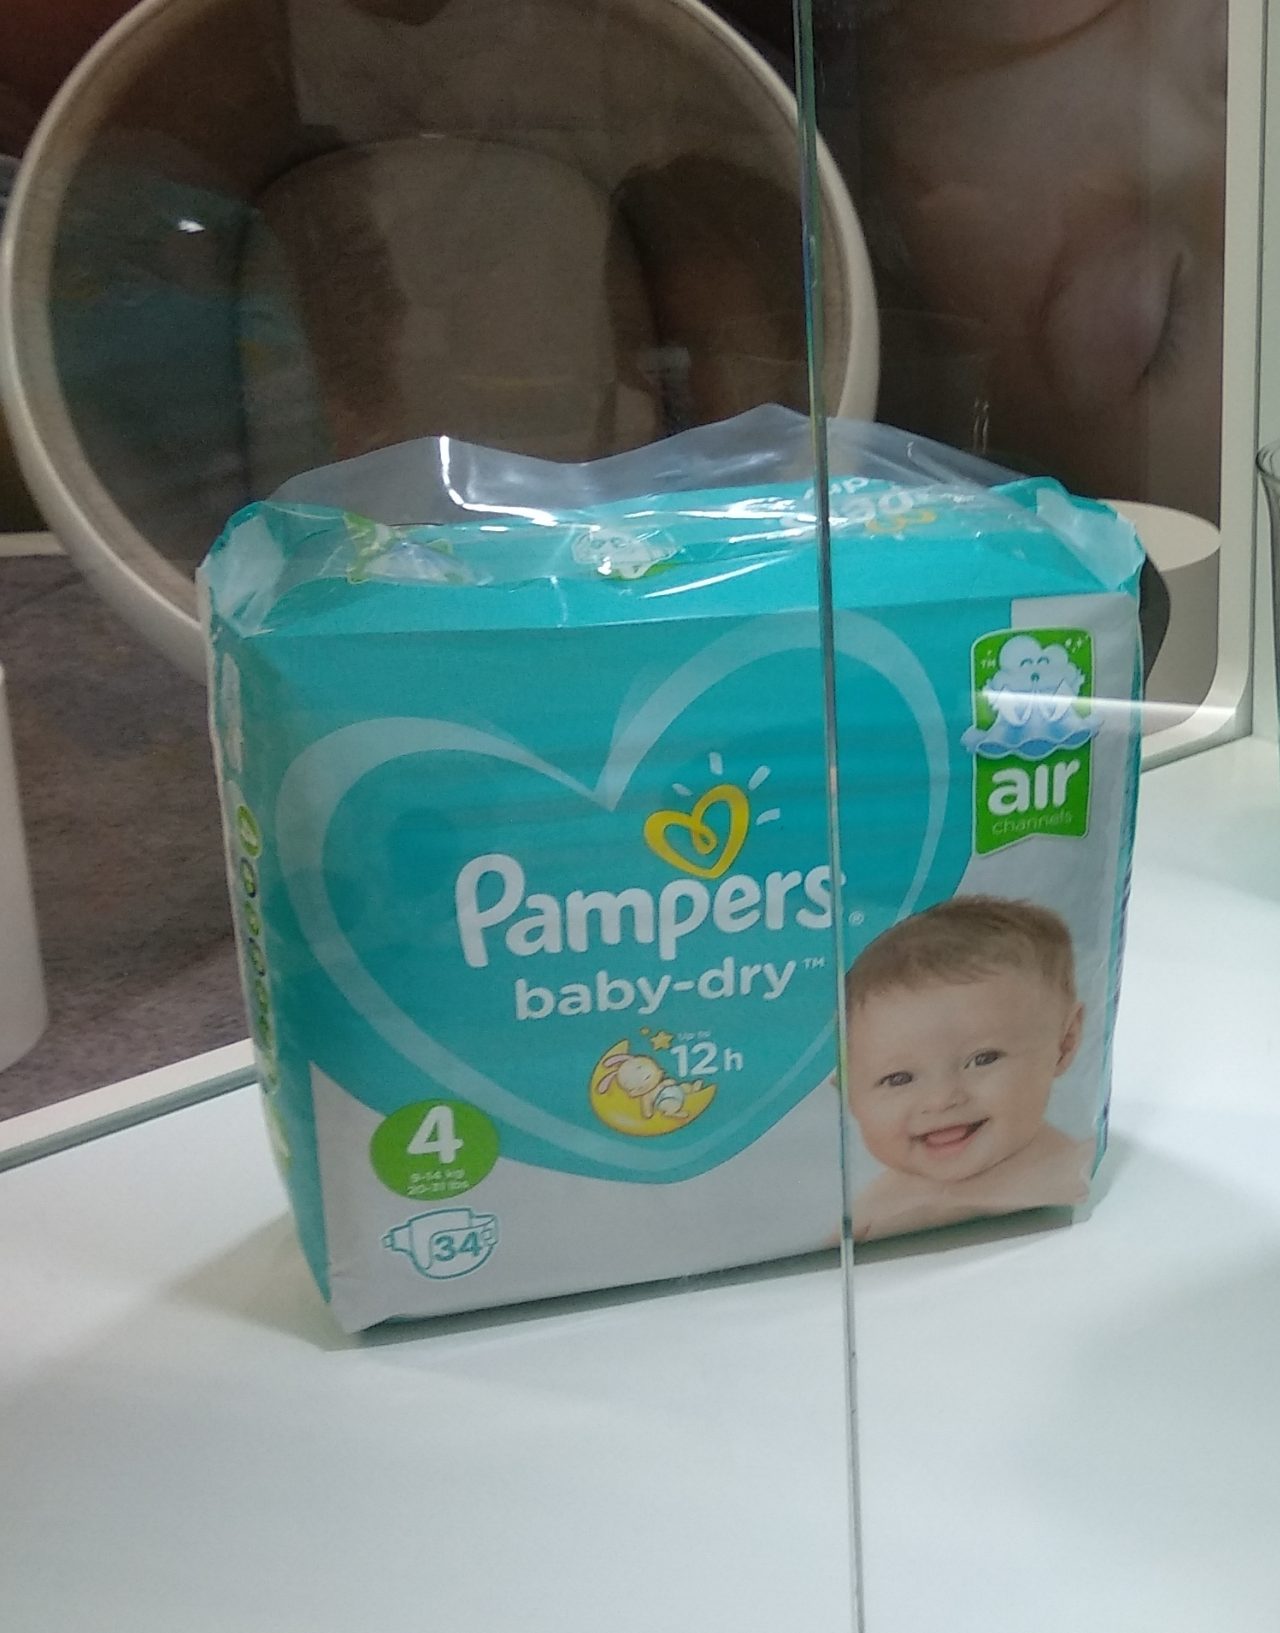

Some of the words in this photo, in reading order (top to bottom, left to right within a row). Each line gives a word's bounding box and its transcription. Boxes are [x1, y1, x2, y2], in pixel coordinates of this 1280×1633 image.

[987, 758, 1081, 817] air
[991, 808, 1074, 836] channels
[454, 853, 847, 968] Pampers
[514, 956, 797, 1021] baby-dry
[406, 1104, 465, 1164] 4
[434, 1230, 482, 1262] 34
